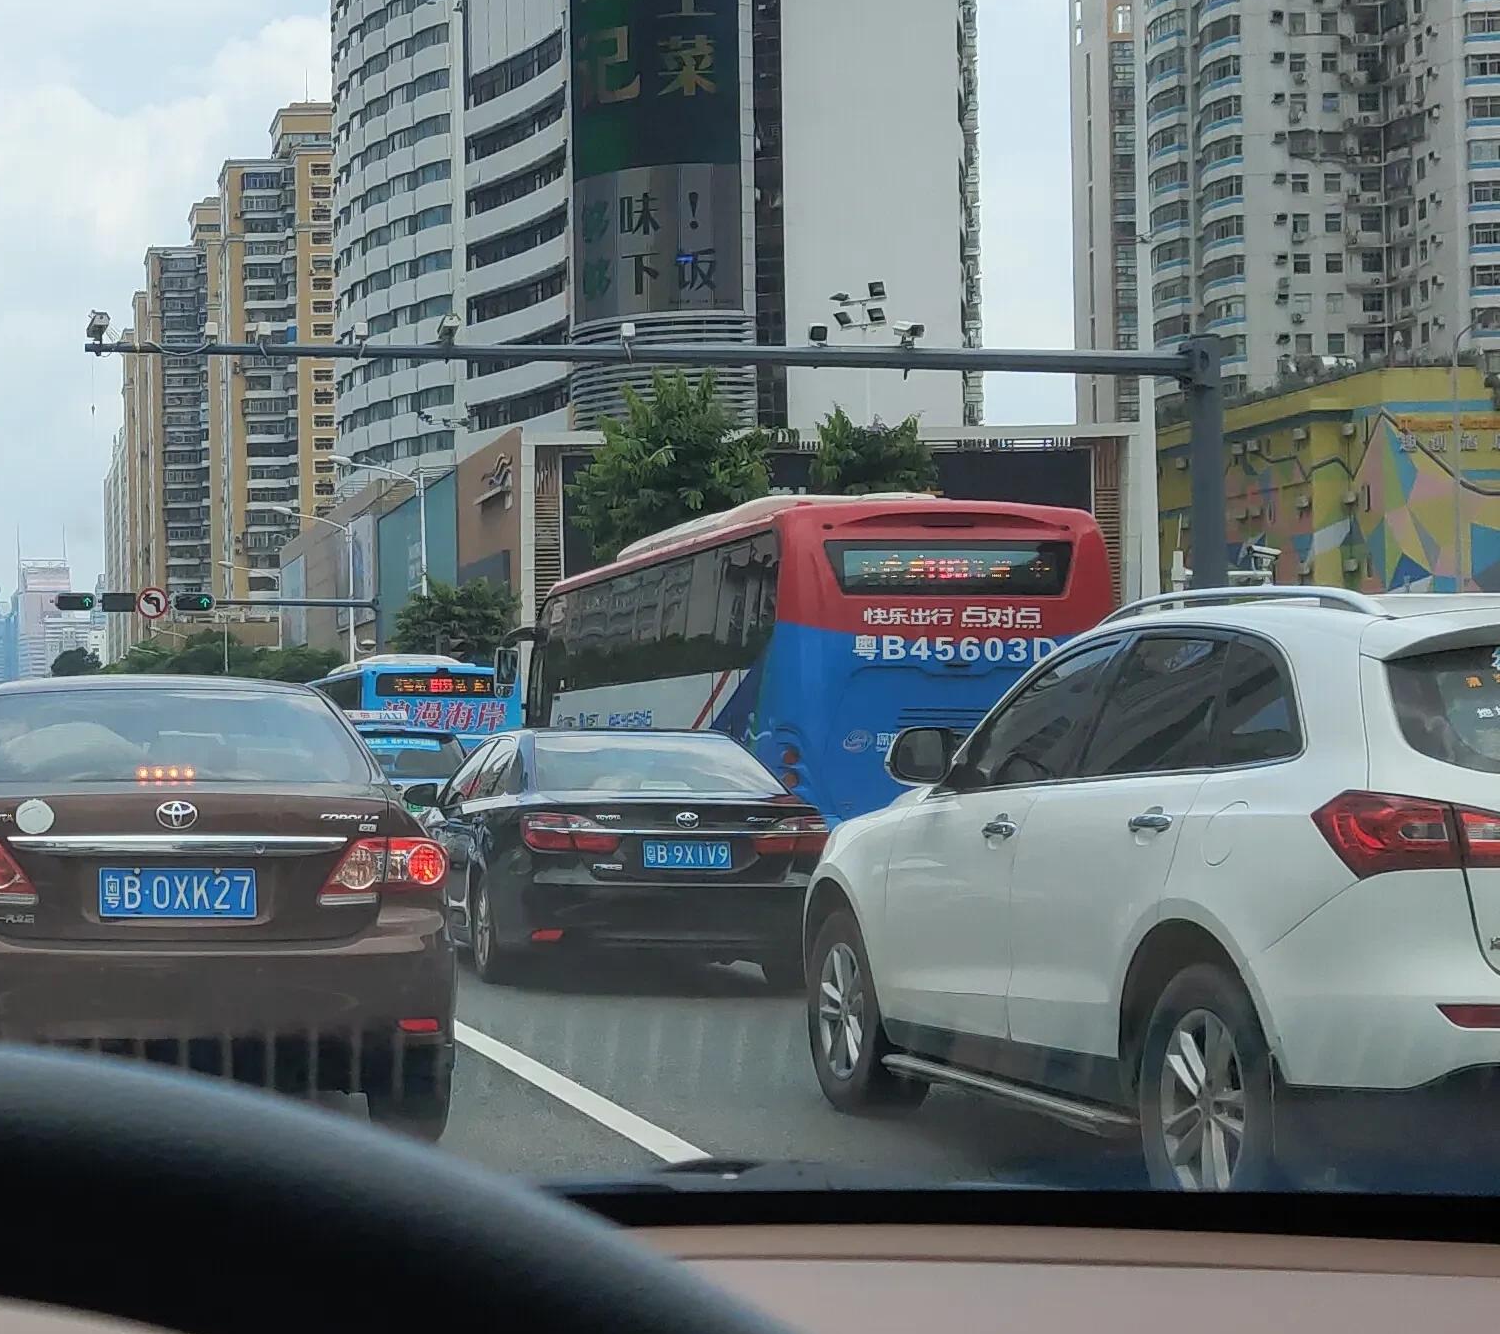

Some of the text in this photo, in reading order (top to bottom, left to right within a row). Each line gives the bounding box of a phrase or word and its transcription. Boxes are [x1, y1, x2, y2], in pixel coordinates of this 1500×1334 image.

[863, 606, 1043, 629] 快乐出行 点对点
[852, 634, 1057, 662] 粤B45603D
